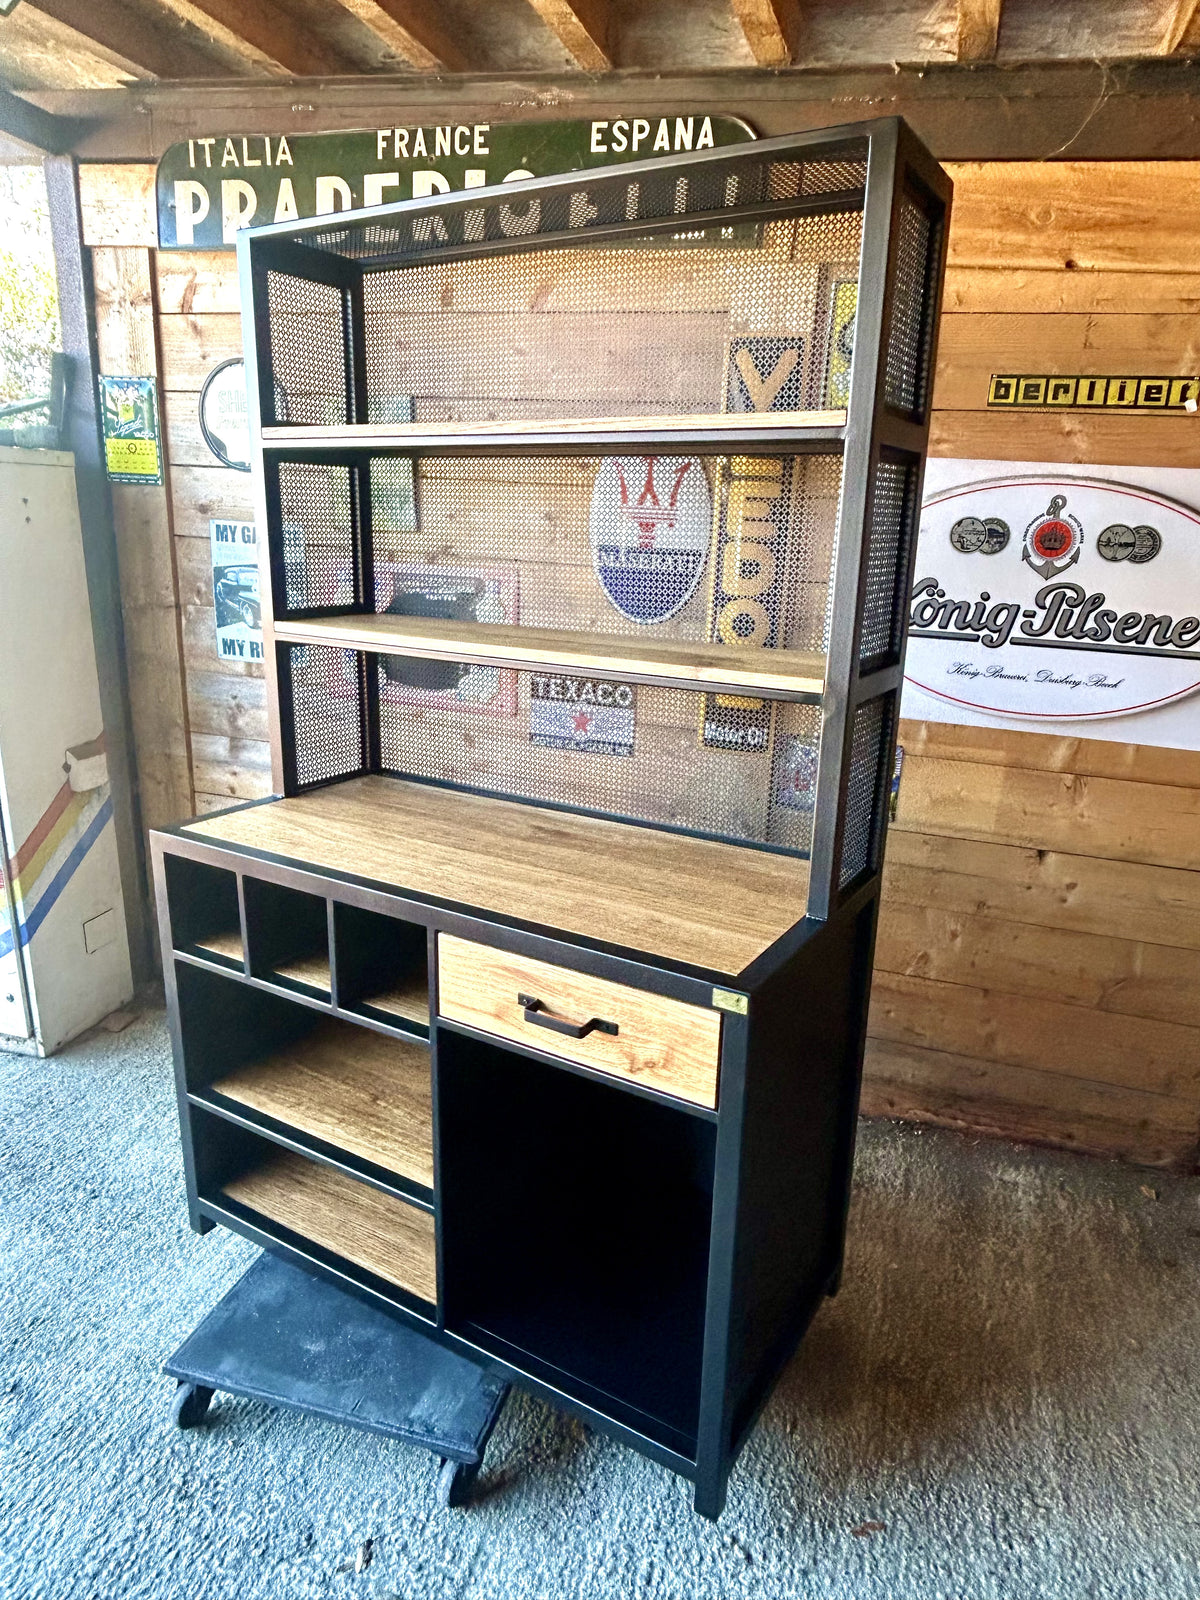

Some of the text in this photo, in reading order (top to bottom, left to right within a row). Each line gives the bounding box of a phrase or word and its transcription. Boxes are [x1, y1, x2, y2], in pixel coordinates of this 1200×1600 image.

[187, 116, 715, 168] ITALIA FRANCE ESPANA
[215, 524, 237, 544] MY
[715, 347, 800, 709] VEDO
[221, 637, 245, 657] MY
[530, 677, 633, 706] TEXACO
